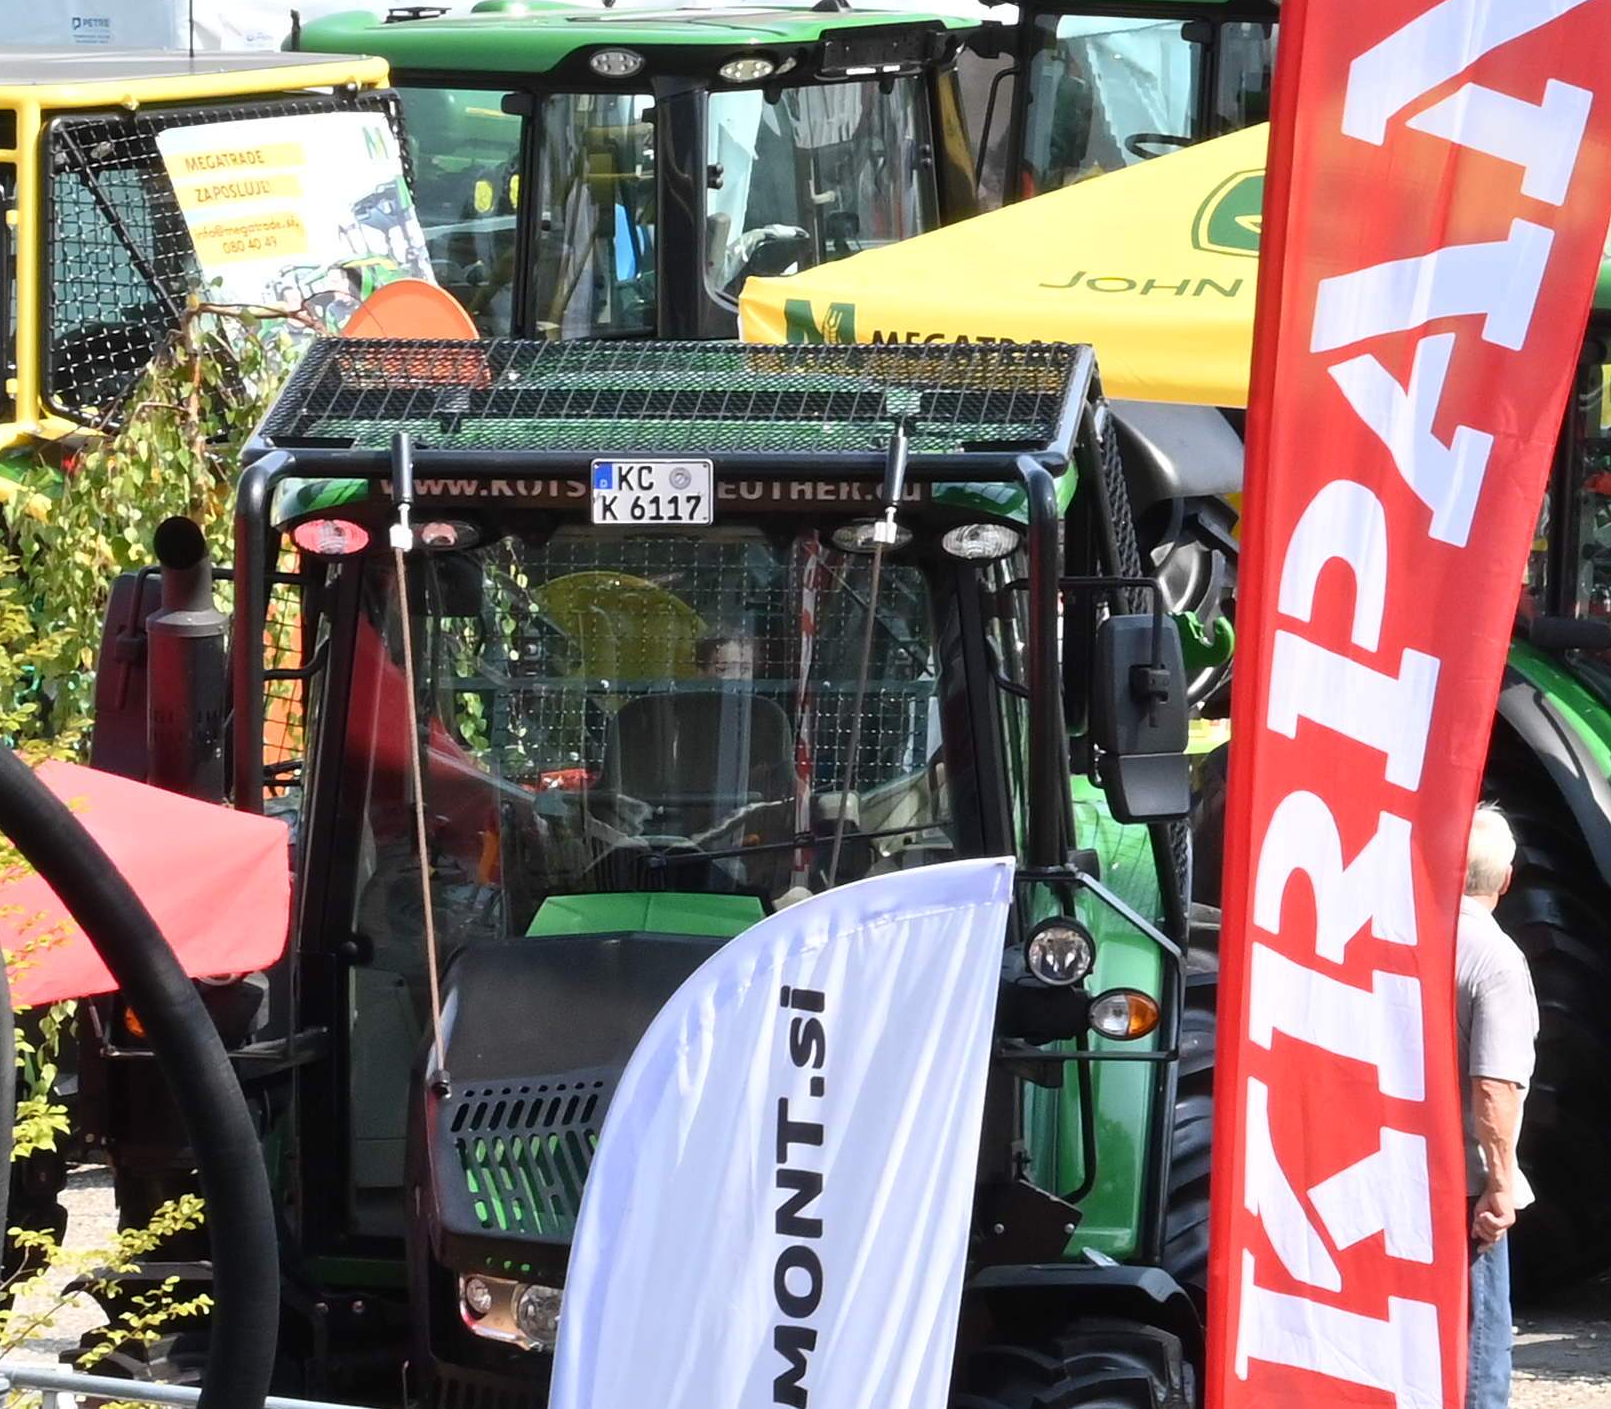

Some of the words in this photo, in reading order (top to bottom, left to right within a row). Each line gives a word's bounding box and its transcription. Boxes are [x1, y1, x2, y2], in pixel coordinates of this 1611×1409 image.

[184, 150, 265, 172] MEGATRADE
[1037, 270, 1244, 298] JOHN
[618, 465, 654, 492] KC
[601, 495, 619, 521] K
[629, 494, 703, 521] 6117
